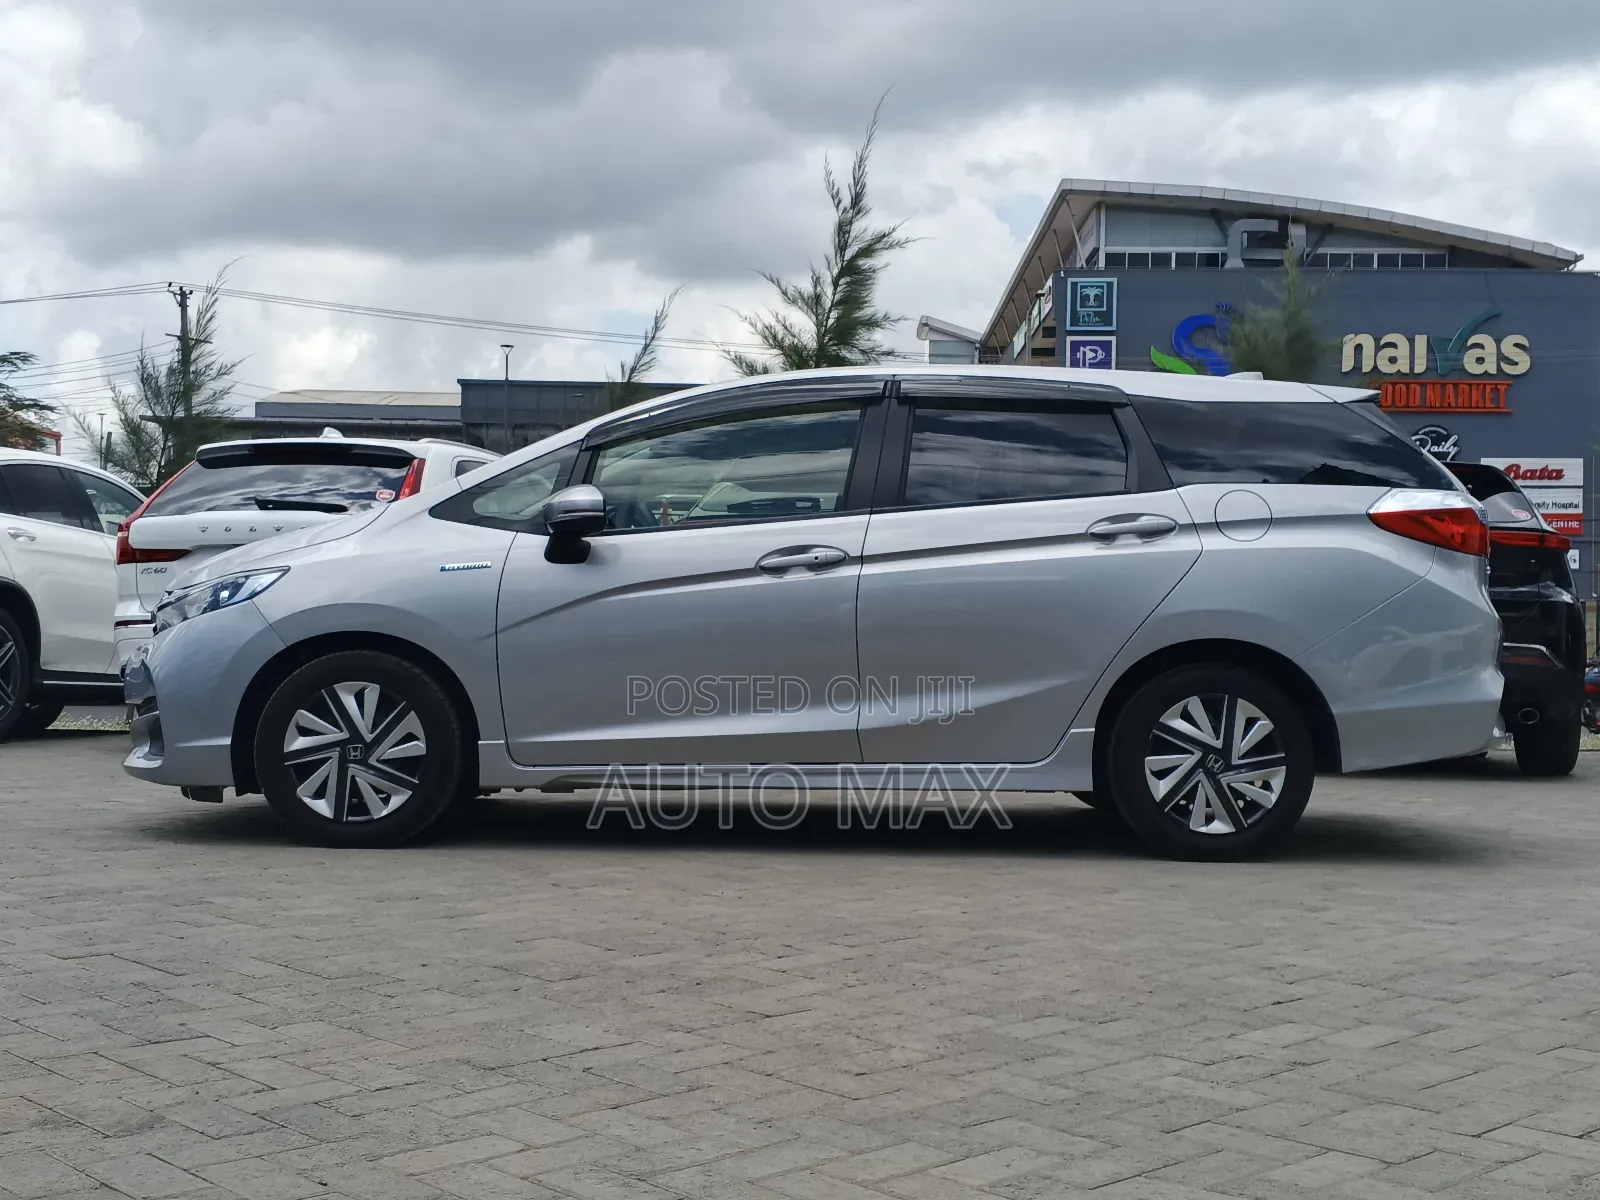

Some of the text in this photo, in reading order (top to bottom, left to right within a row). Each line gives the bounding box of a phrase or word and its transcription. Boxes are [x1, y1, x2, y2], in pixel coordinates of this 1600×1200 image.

[1380, 383, 1508, 408] OOD MARKET
[1552, 500, 1580, 509] Hospital
[199, 525, 307, 533] VOLV
